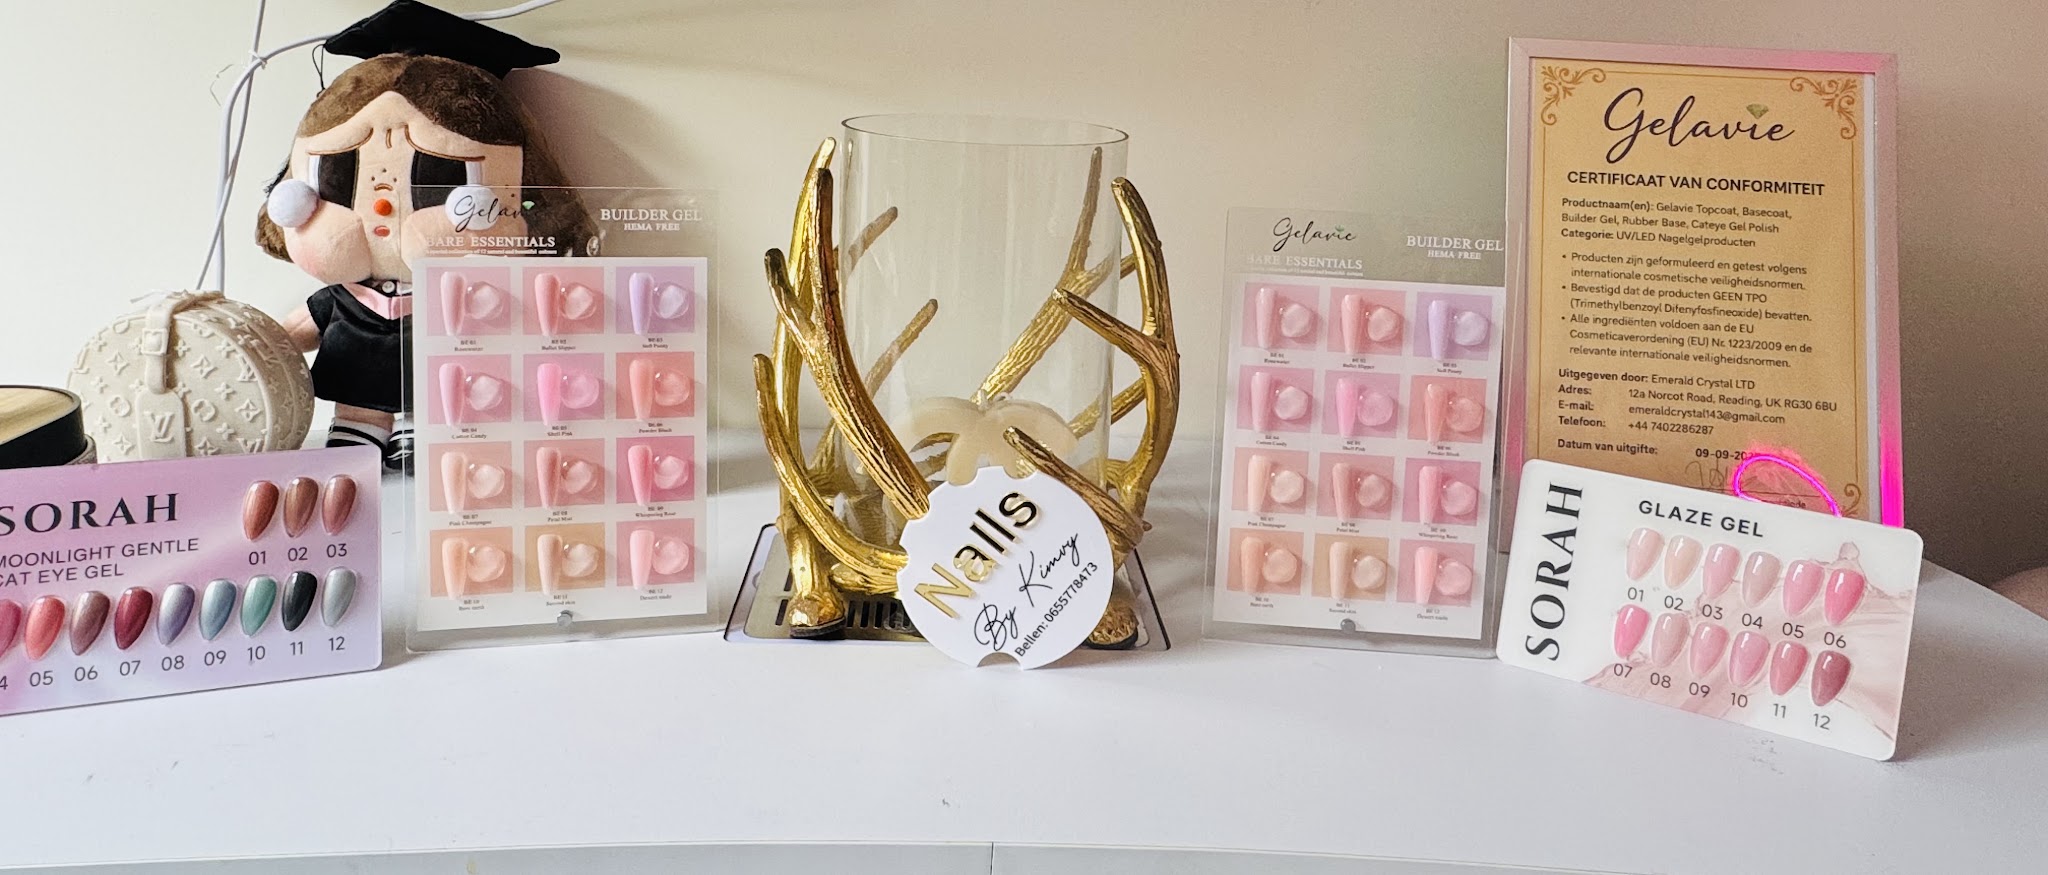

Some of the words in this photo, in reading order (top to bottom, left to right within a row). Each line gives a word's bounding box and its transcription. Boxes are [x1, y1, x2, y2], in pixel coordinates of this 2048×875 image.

[1603, 87, 1795, 164] Gelavie
[1567, 170, 1666, 188] CERTIFICAAT
[1669, 174, 1702, 190] VAN
[1706, 177, 1825, 196] CONFORMITEIT
[454, 195, 527, 232] Gelav
[600, 208, 668, 221] BUILDER
[672, 209, 702, 221] GEL
[1562, 198, 1654, 211] Productnaam(en):
[1656, 202, 1693, 213] Gelavie
[1696, 204, 1739, 217] Topcoat,
[1742, 207, 1792, 219] Basecoat,
[624, 223, 653, 231] HEMA
[656, 223, 680, 231] FREE
[1561, 213, 1596, 223] Builder
[1600, 215, 1619, 226] Gel,
[1622, 216, 1658, 226] Rubber
[1661, 218, 1689, 229] Base,
[1691, 220, 1726, 232] Cateye
[1729, 221, 1746, 231] Gel
[1749, 222, 1779, 233] Polish
[427, 236, 464, 247] BARE
[471, 236, 556, 248] ESSENTIALS
[1272, 217, 1356, 252] Gelavie
[1407, 235, 1472, 250] BUILDER
[1475, 239, 1504, 251] GEL
[1561, 228, 1613, 240] Categorie:
[1616, 231, 1655, 241] UV/LED
[1658, 233, 1756, 247] Nagelgelproducten
[1286, 255, 1362, 270] ESSENTIALS
[1427, 250, 1455, 259] HEMA
[1458, 251, 1482, 260] FREE
[1571, 252, 1623, 264] Producten
[1626, 255, 1643, 266] zijn
[1646, 256, 1714, 268] geformuleerd
[1717, 261, 1730, 269] en
[1733, 262, 1764, 272] getest
[1768, 263, 1807, 275] volgens
[1571, 268, 1640, 280] internationale
[1643, 272, 1707, 284] cosmetische
[1710, 275, 1805, 290] veiligheidsnormen.
[1571, 283, 1620, 296] Bevestigd
[1623, 286, 1640, 295] dat
[1643, 287, 1655, 296] de
[1658, 289, 1710, 300] producten
[1713, 291, 1742, 301] GEEN
[1745, 293, 1767, 303] TPO
[1570, 298, 1662, 314] (Trimethylbenzoyl
[1765, 310, 1812, 321] bevatten.
[1570, 313, 1589, 323] Alle
[1592, 315, 1656, 327] ingrediënten
[1660, 318, 1700, 330] voldoen
[1703, 323, 1721, 331] aan
[1724, 323, 1736, 332] de
[1740, 323, 1754, 333] EU
[1570, 329, 1684, 347] Cosmeticaverordening
[1687, 336, 1709, 348] (EU)
[1728, 339, 1781, 351] 1223/2009
[1784, 344, 1797, 352] en
[1800, 343, 1812, 353] de
[1570, 345, 1616, 356] relevante
[1620, 349, 1689, 362] internationale
[1693, 352, 1791, 368] veiligheidsnormen.
[1558, 368, 1618, 381] Uitgegeven
[1621, 372, 1648, 382] door:
[1651, 374, 1693, 385] Emerald
[1696, 377, 1733, 389] Crystal
[1735, 379, 1755, 390] LTD
[1558, 384, 1591, 395] Adres:
[1628, 389, 1645, 398] 12a
[1648, 390, 1684, 401] Norcot
[1686, 392, 1715, 404] Road,
[1718, 394, 1762, 408] Reading,
[1765, 397, 1781, 408] UK
[1784, 399, 1812, 409] RG30
[1815, 401, 1837, 411] 6BU
[1558, 400, 1594, 411] E-mail:
[1558, 416, 1606, 427] Telefoon:
[1628, 421, 1647, 430] +44
[1651, 421, 1714, 435] 7402286287
[1557, 439, 1591, 450] Datum
[1595, 442, 1613, 451] van
[1616, 442, 1658, 455] uitgifte:
[0, 492, 179, 537] SORAH
[1638, 500, 1713, 528] GLAZE
[1720, 516, 1764, 538] GEL
[122, 538, 199, 558] GENTLE
[248, 551, 267, 565] 01
[287, 547, 308, 562] 02
[326, 543, 348, 559] 03
[38, 567, 78, 584] EYE
[84, 563, 124, 580] GEL
[1525, 481, 1583, 661] SORAH
[1015, 621, 1049, 657] Bellen:
[1044, 562, 1098, 622] 0655778473
[1627, 587, 1644, 603] 01
[1664, 595, 1684, 611] 02
[1702, 604, 1723, 620] 03
[1741, 613, 1764, 629] 04
[1782, 622, 1805, 639] 05
[1824, 631, 1847, 649] 06
[974, 603, 1018, 651] By
[0, 675, 8, 690] 4
[29, 670, 53, 687] 05
[74, 665, 98, 682] 06
[119, 660, 141, 676] 07
[161, 655, 185, 671] 08
[203, 650, 227, 666] 09
[247, 646, 266, 661] 10
[290, 642, 304, 655] 11
[328, 637, 345, 651] 12
[1613, 663, 1633, 679] 07
[1650, 672, 1671, 689] 08
[1689, 682, 1711, 698] 09
[1730, 692, 1748, 708] 10
[1772, 703, 1787, 719] 11
[1813, 713, 1831, 731] 12
